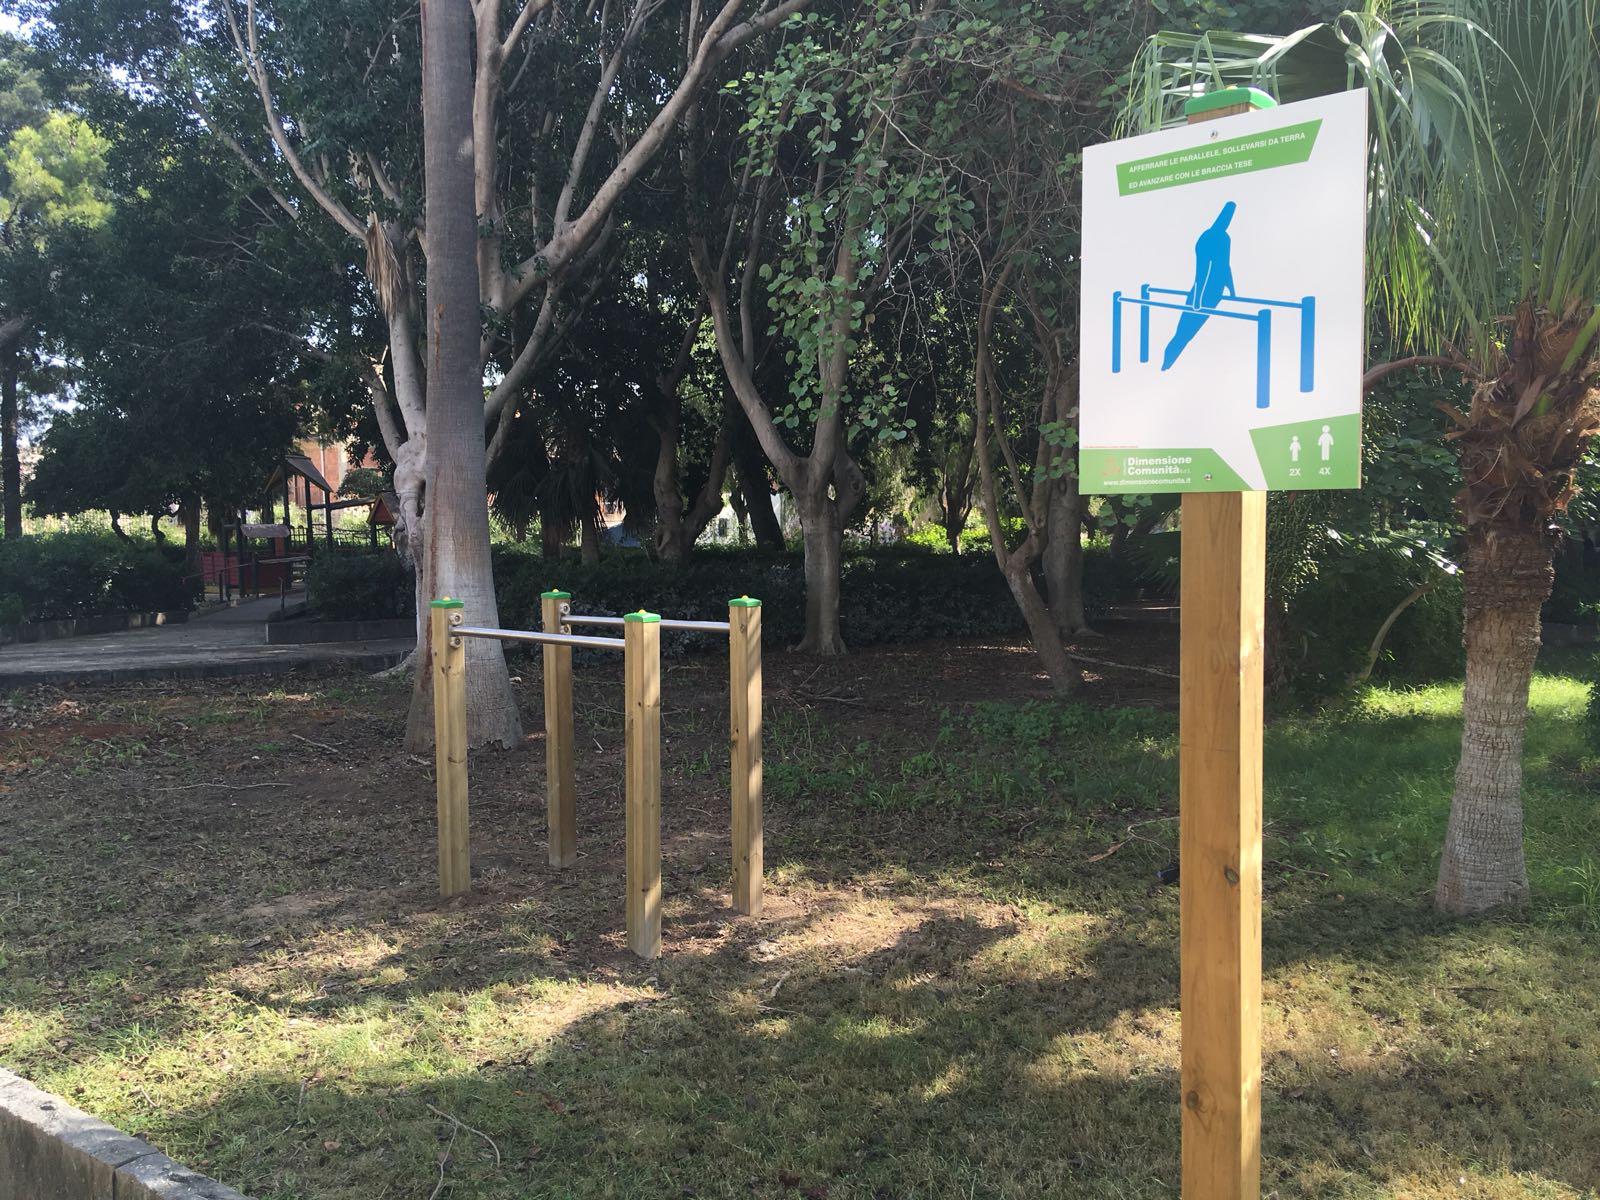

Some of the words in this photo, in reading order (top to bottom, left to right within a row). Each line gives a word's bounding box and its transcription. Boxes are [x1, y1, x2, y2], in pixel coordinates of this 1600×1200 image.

[1129, 160, 1168, 173] AFFERRARE
[1222, 140, 1267, 155] SOLLEVARSI
[1268, 138, 1279, 146] DA
[1280, 132, 1306, 144] TERRA
[1129, 181, 1138, 189] ED
[1139, 174, 1173, 188] AVANZARE
[1175, 171, 1190, 180] CON
[1201, 164, 1233, 176] BRACCIA
[1234, 159, 1253, 169] TESE
[1128, 456, 1192, 466] Dimensione
[1128, 465, 1179, 475] Comunità
[1289, 468, 1301, 476] 2X
[1319, 467, 1331, 475] 4X
